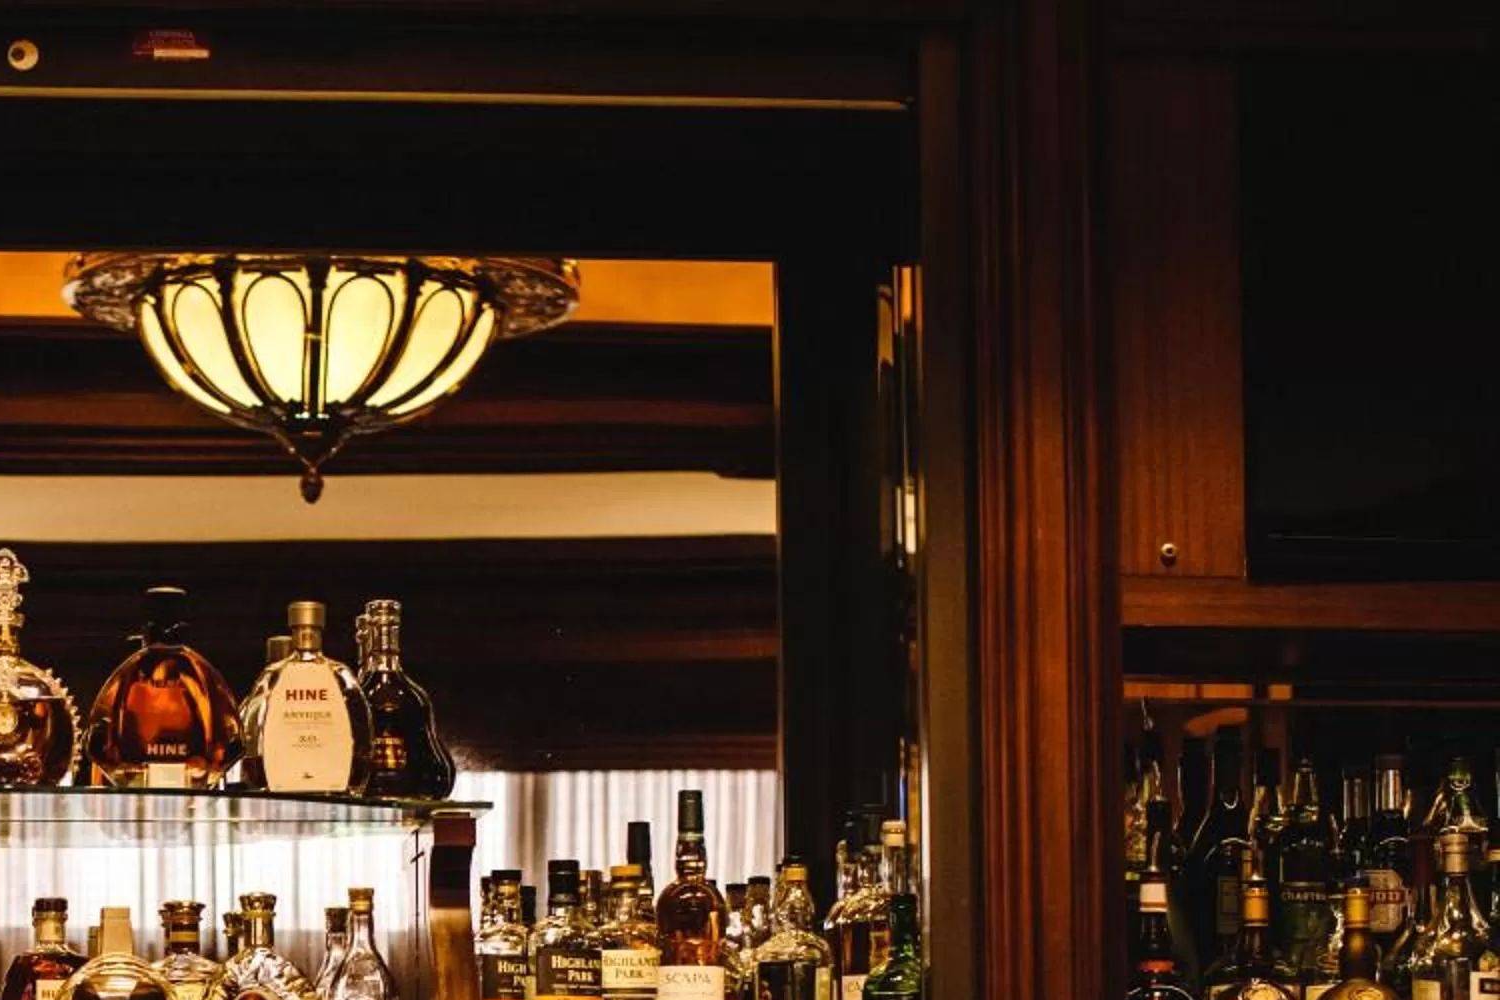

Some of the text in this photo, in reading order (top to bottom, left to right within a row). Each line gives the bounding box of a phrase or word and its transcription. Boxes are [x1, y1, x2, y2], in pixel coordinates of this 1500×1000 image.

[284, 688, 329, 701] HINE
[146, 743, 189, 756] HINE
[567, 970, 594, 983] PARK
[615, 968, 646, 979] PARK
[664, 973, 711, 984] SCAPA
